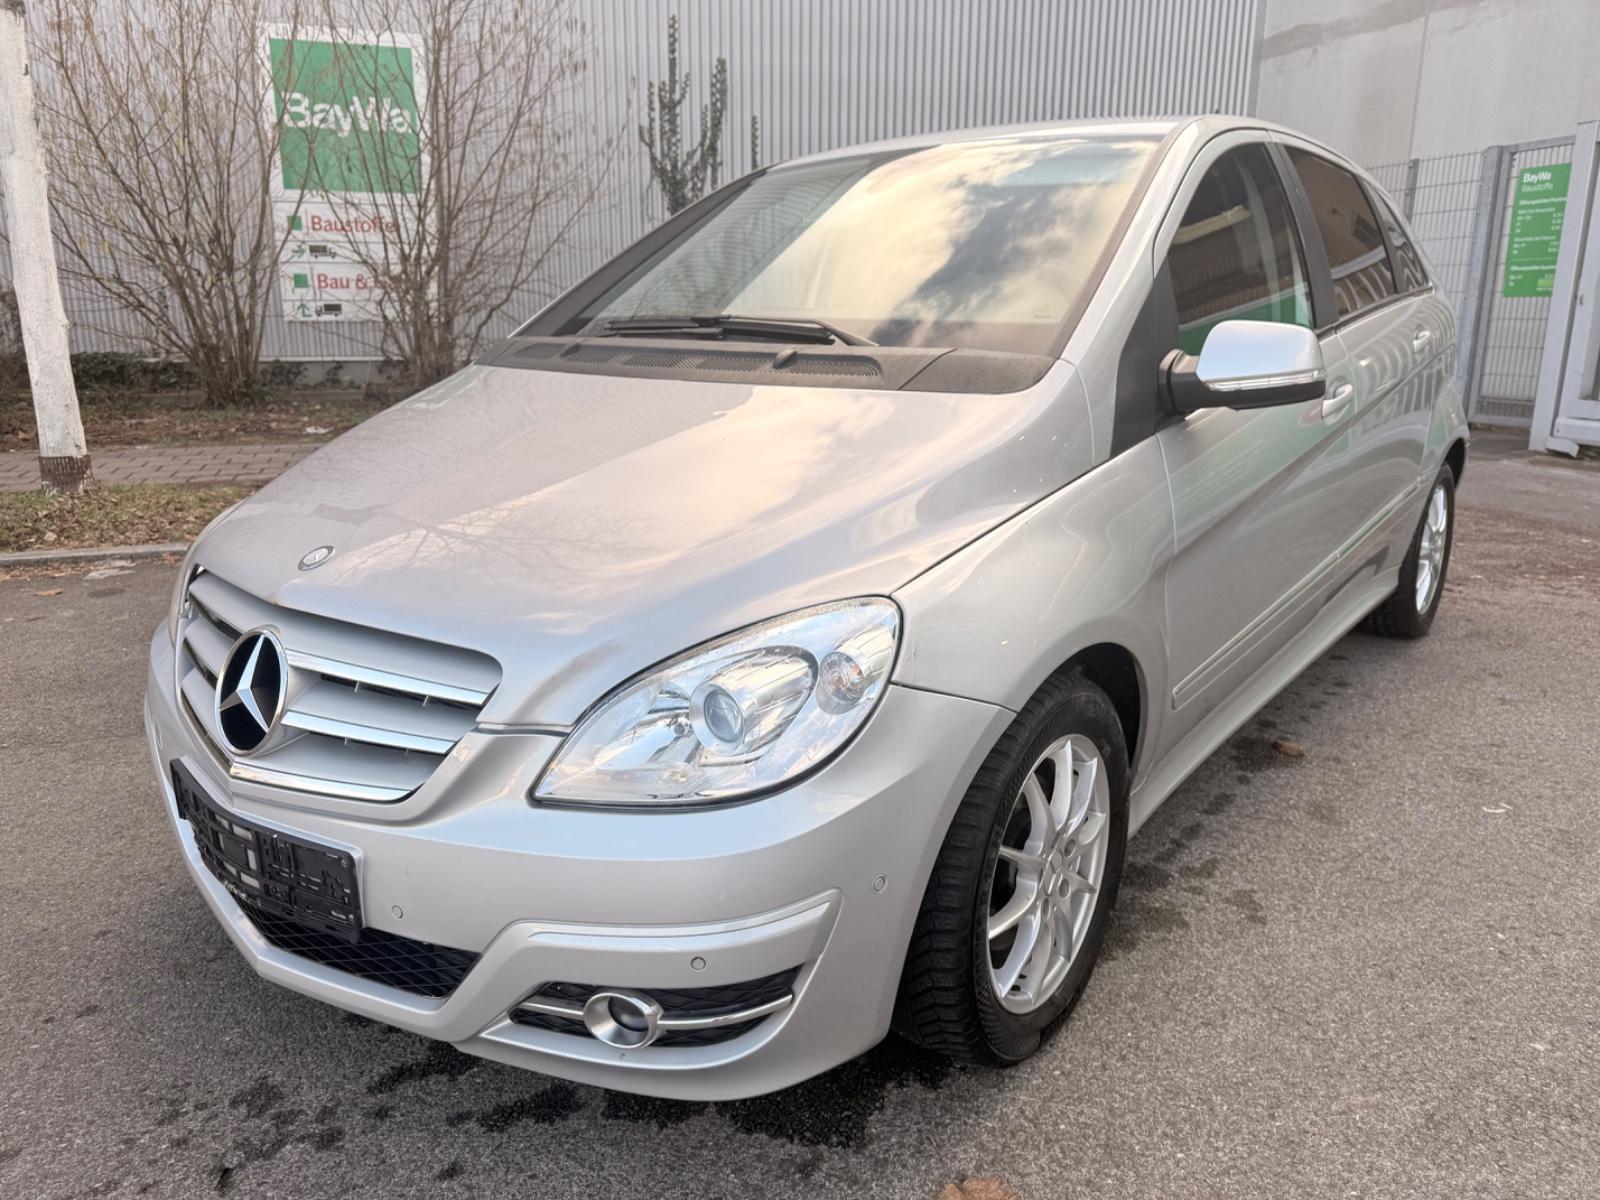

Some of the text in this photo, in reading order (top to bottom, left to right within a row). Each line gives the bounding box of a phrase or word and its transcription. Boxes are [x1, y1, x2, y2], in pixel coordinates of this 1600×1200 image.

[282, 92, 412, 137] BayWa
[1523, 171, 1552, 184] BayWa
[317, 273, 350, 289] Bau
[356, 273, 369, 290] &
